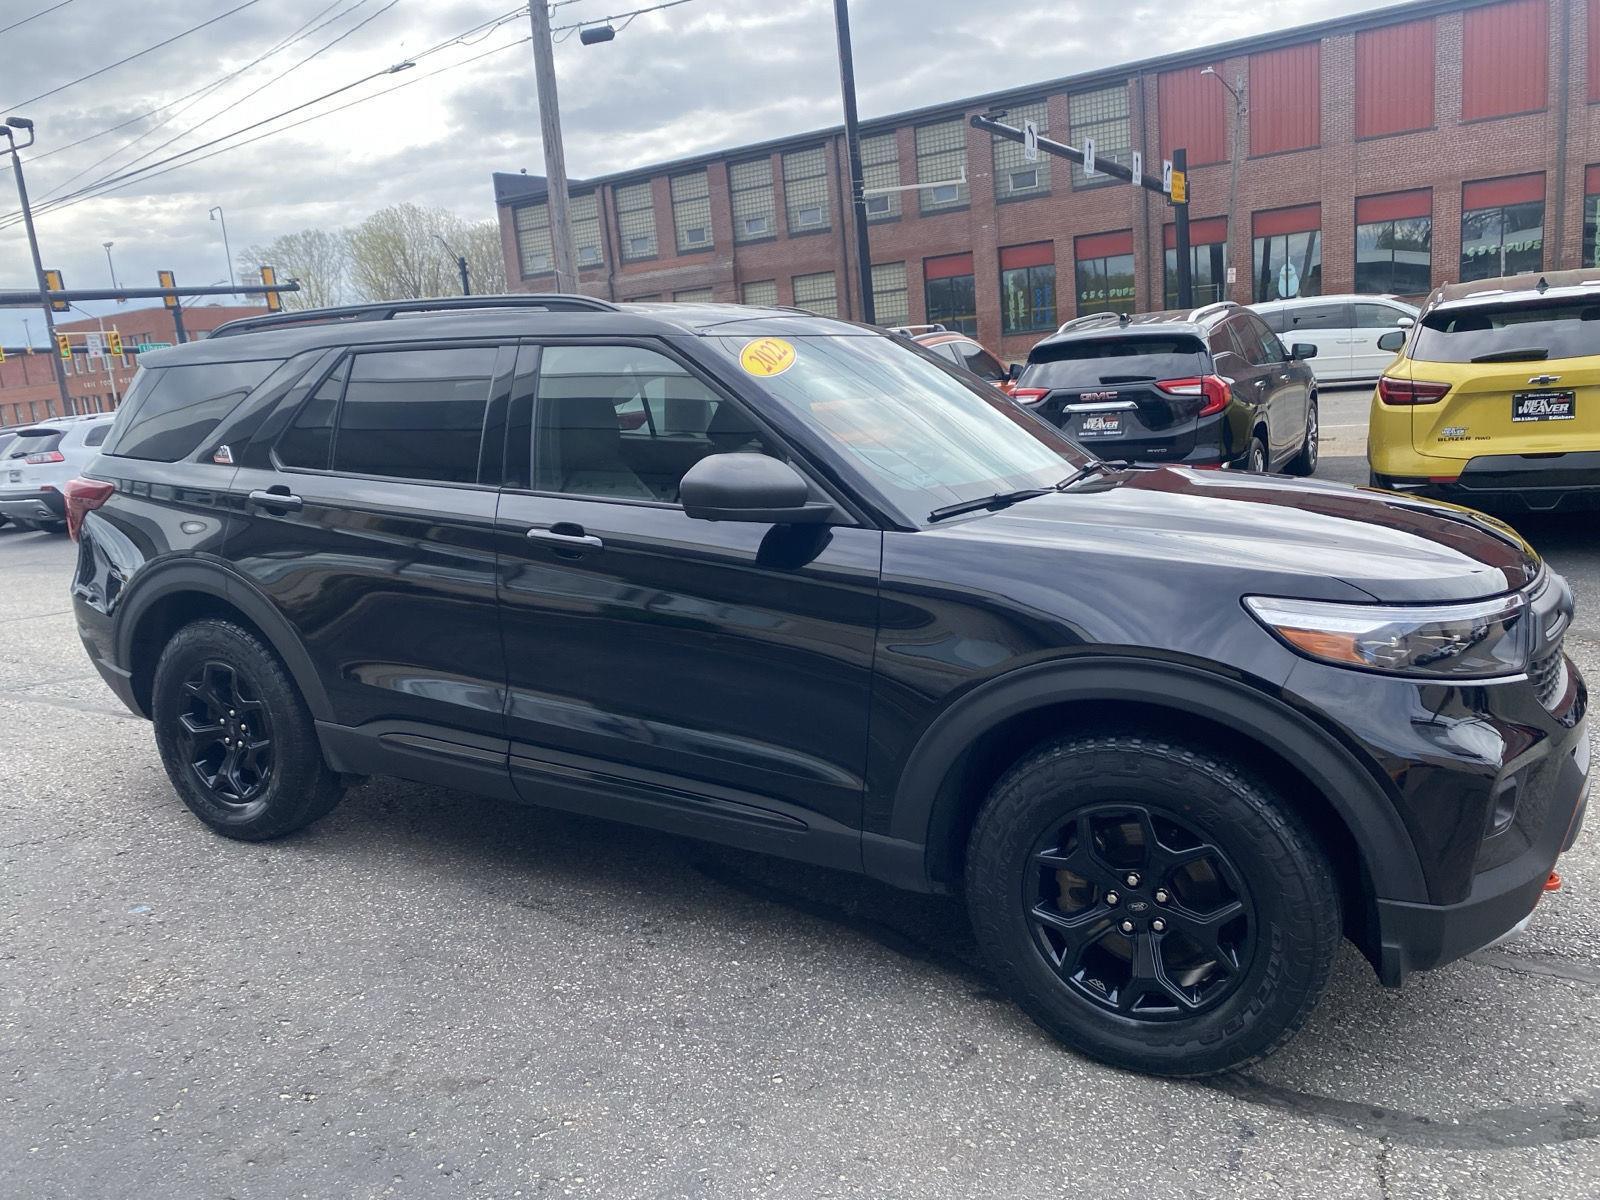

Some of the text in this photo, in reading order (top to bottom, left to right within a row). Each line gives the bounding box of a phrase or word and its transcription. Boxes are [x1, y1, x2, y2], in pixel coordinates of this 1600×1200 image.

[1080, 391, 1118, 401] GMC
[1524, 398, 1549, 407] RICK
[1518, 403, 1570, 414] WEAVER
[1082, 421, 1119, 430] WEAVER
